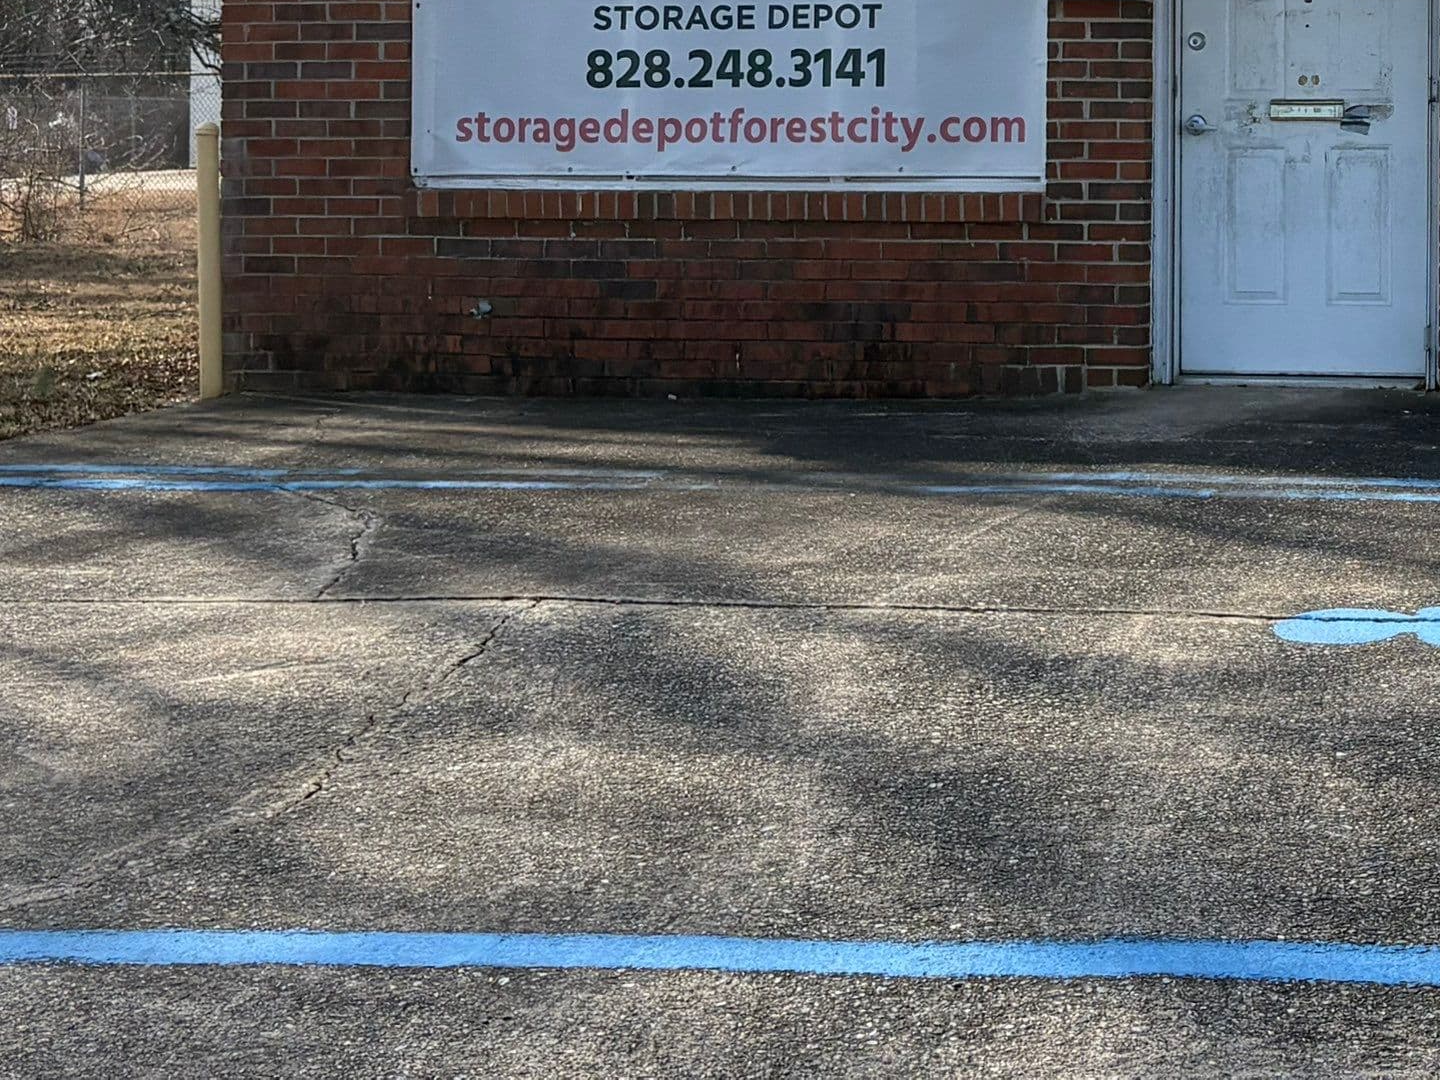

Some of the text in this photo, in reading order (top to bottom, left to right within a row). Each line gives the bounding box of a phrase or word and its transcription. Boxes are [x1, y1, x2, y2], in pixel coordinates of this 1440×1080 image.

[593, 3, 882, 31] STORAGE DEPOT
[586, 47, 886, 89] 828.248.3141
[455, 106, 1027, 153] storagedepotforestcity.com
